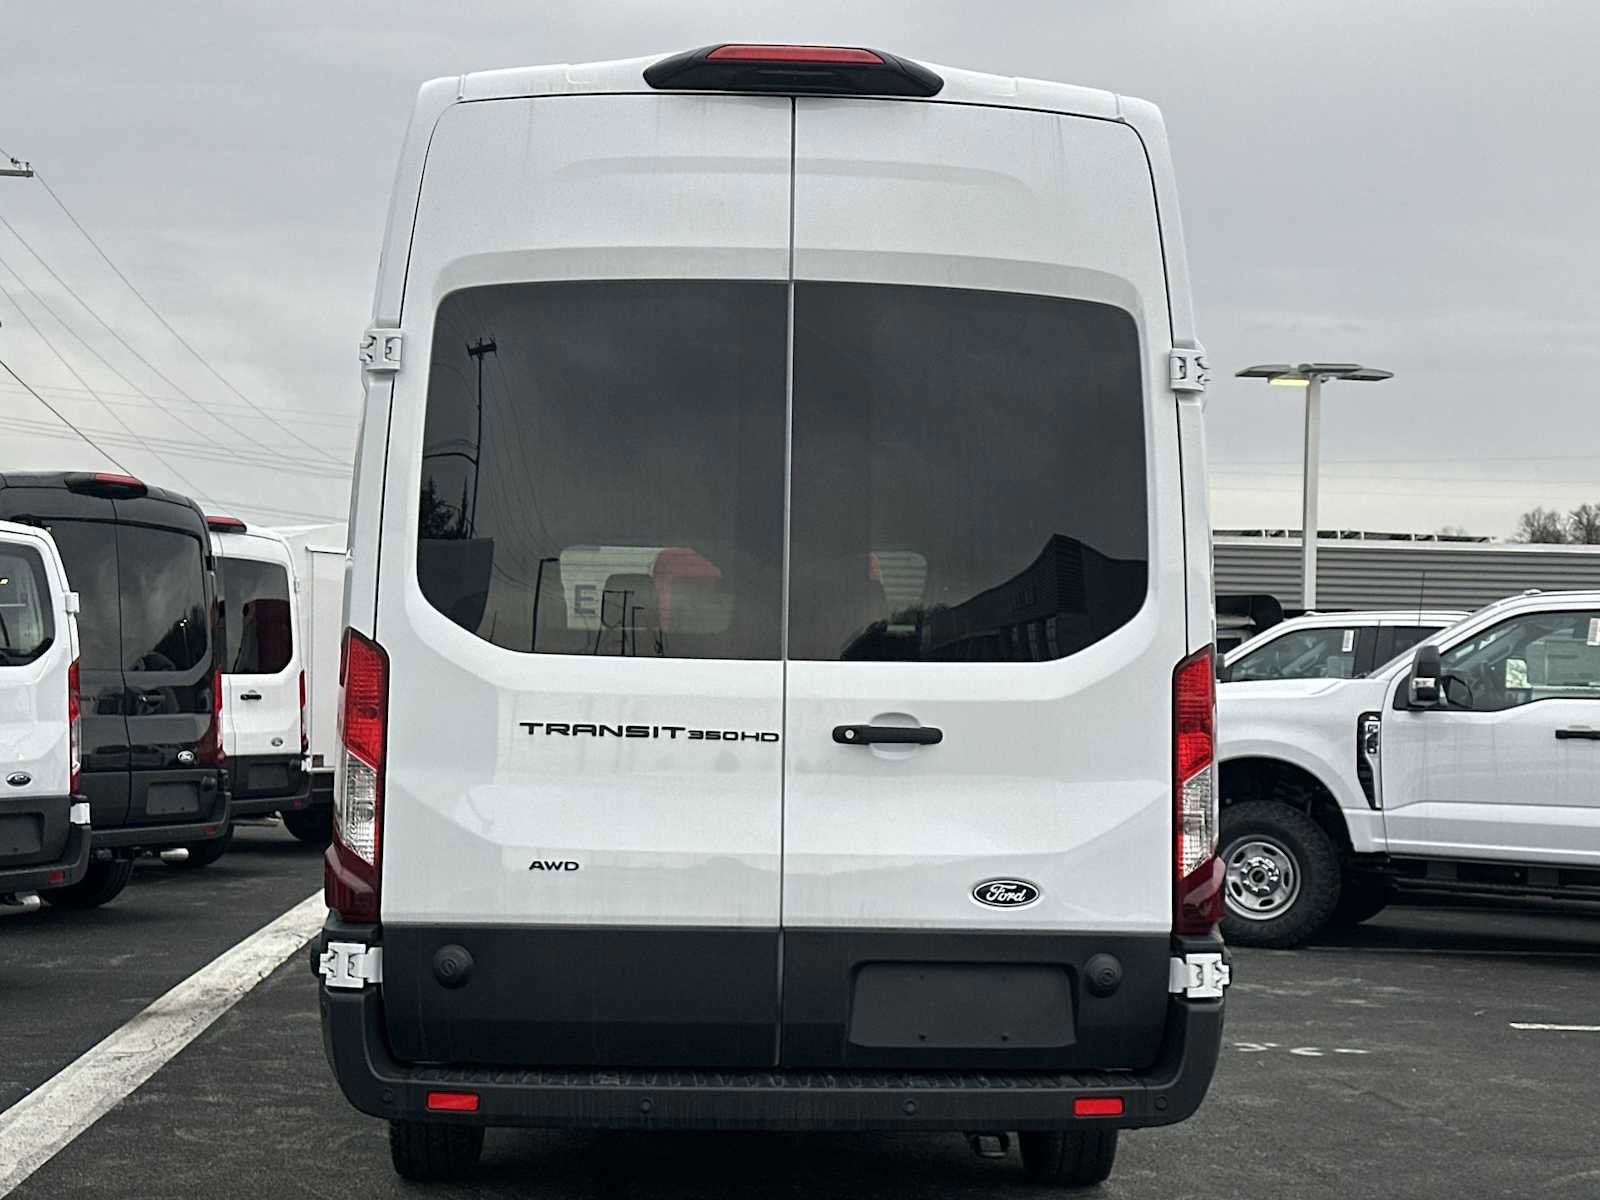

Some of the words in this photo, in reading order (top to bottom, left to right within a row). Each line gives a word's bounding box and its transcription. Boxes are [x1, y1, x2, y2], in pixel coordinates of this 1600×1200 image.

[520, 722, 686, 739] TRANSIT
[528, 860, 580, 872] AWD
[985, 883, 1027, 902] Ford
